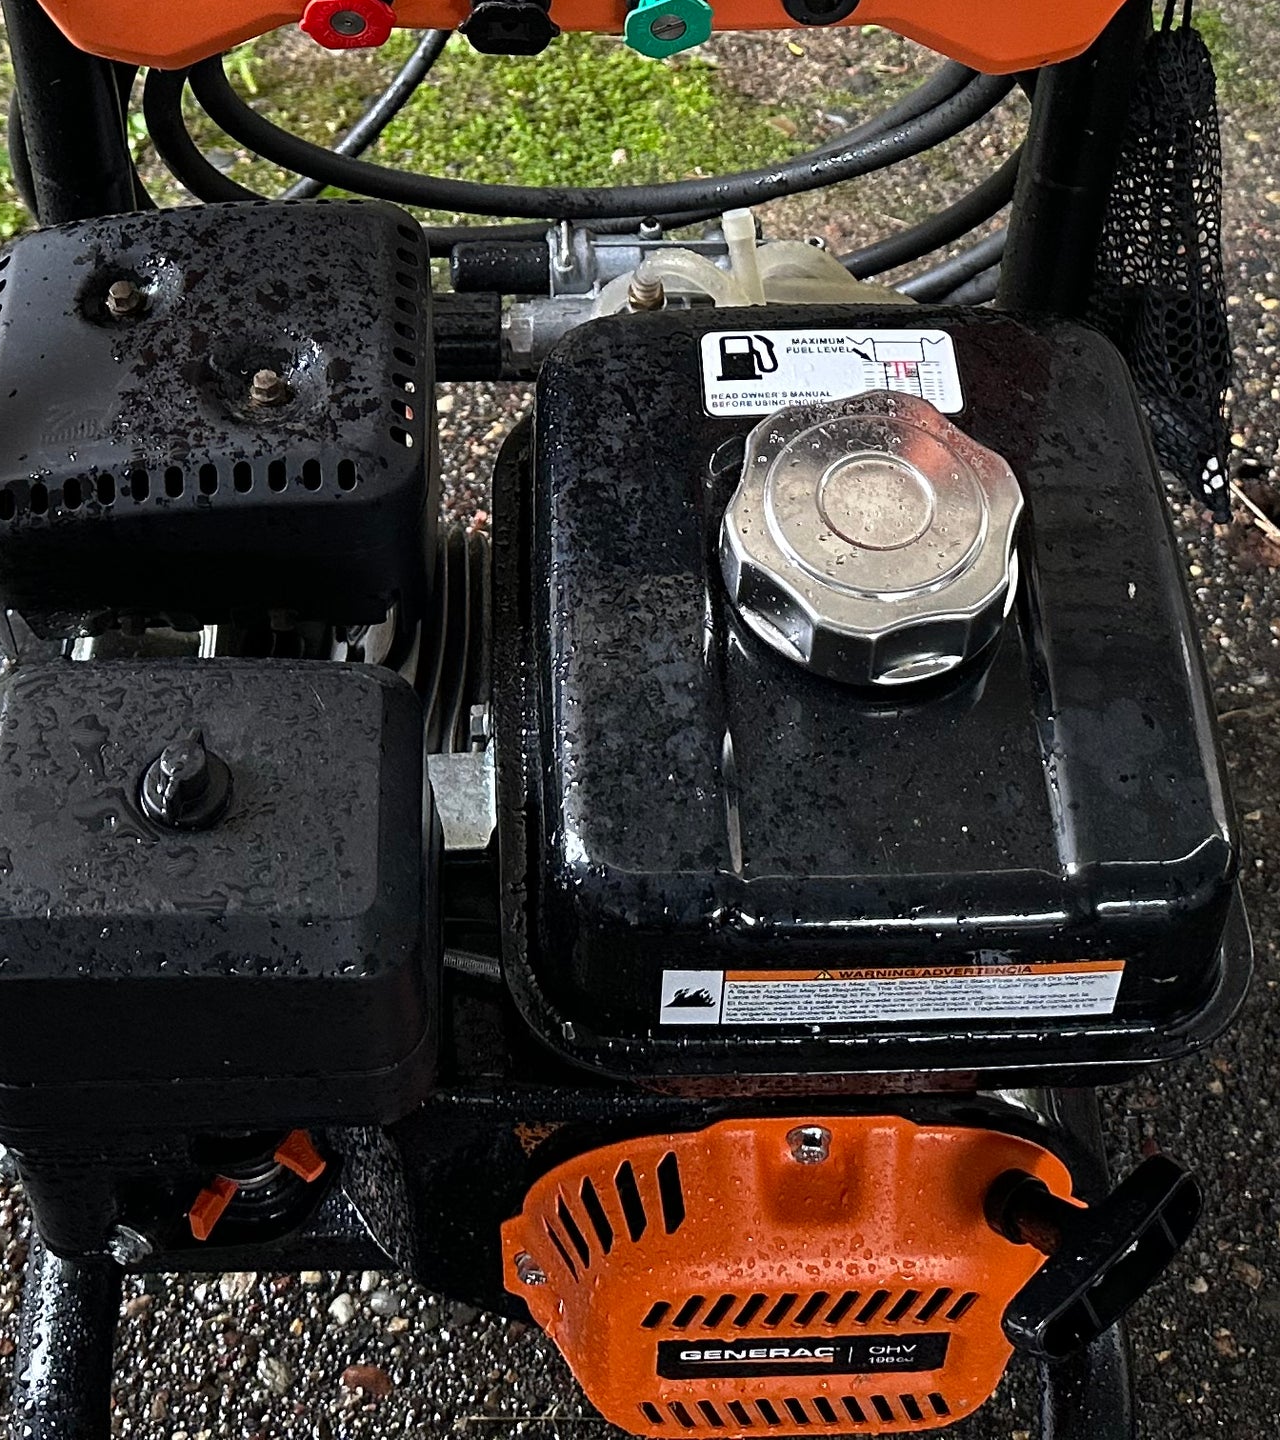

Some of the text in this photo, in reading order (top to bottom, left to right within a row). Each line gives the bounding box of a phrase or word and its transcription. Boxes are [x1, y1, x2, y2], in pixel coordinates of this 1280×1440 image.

[786, 345, 852, 354] FUEL LEVEL
[711, 392, 739, 400] READ
[790, 390, 832, 398] MANUAL
[712, 400, 753, 408] BEFORE
[754, 399, 786, 407] USING
[839, 966, 1032, 978] WARNING/ADVERTENCIA
[680, 1347, 834, 1361] GENERAC
[869, 1344, 917, 1355] OHV
